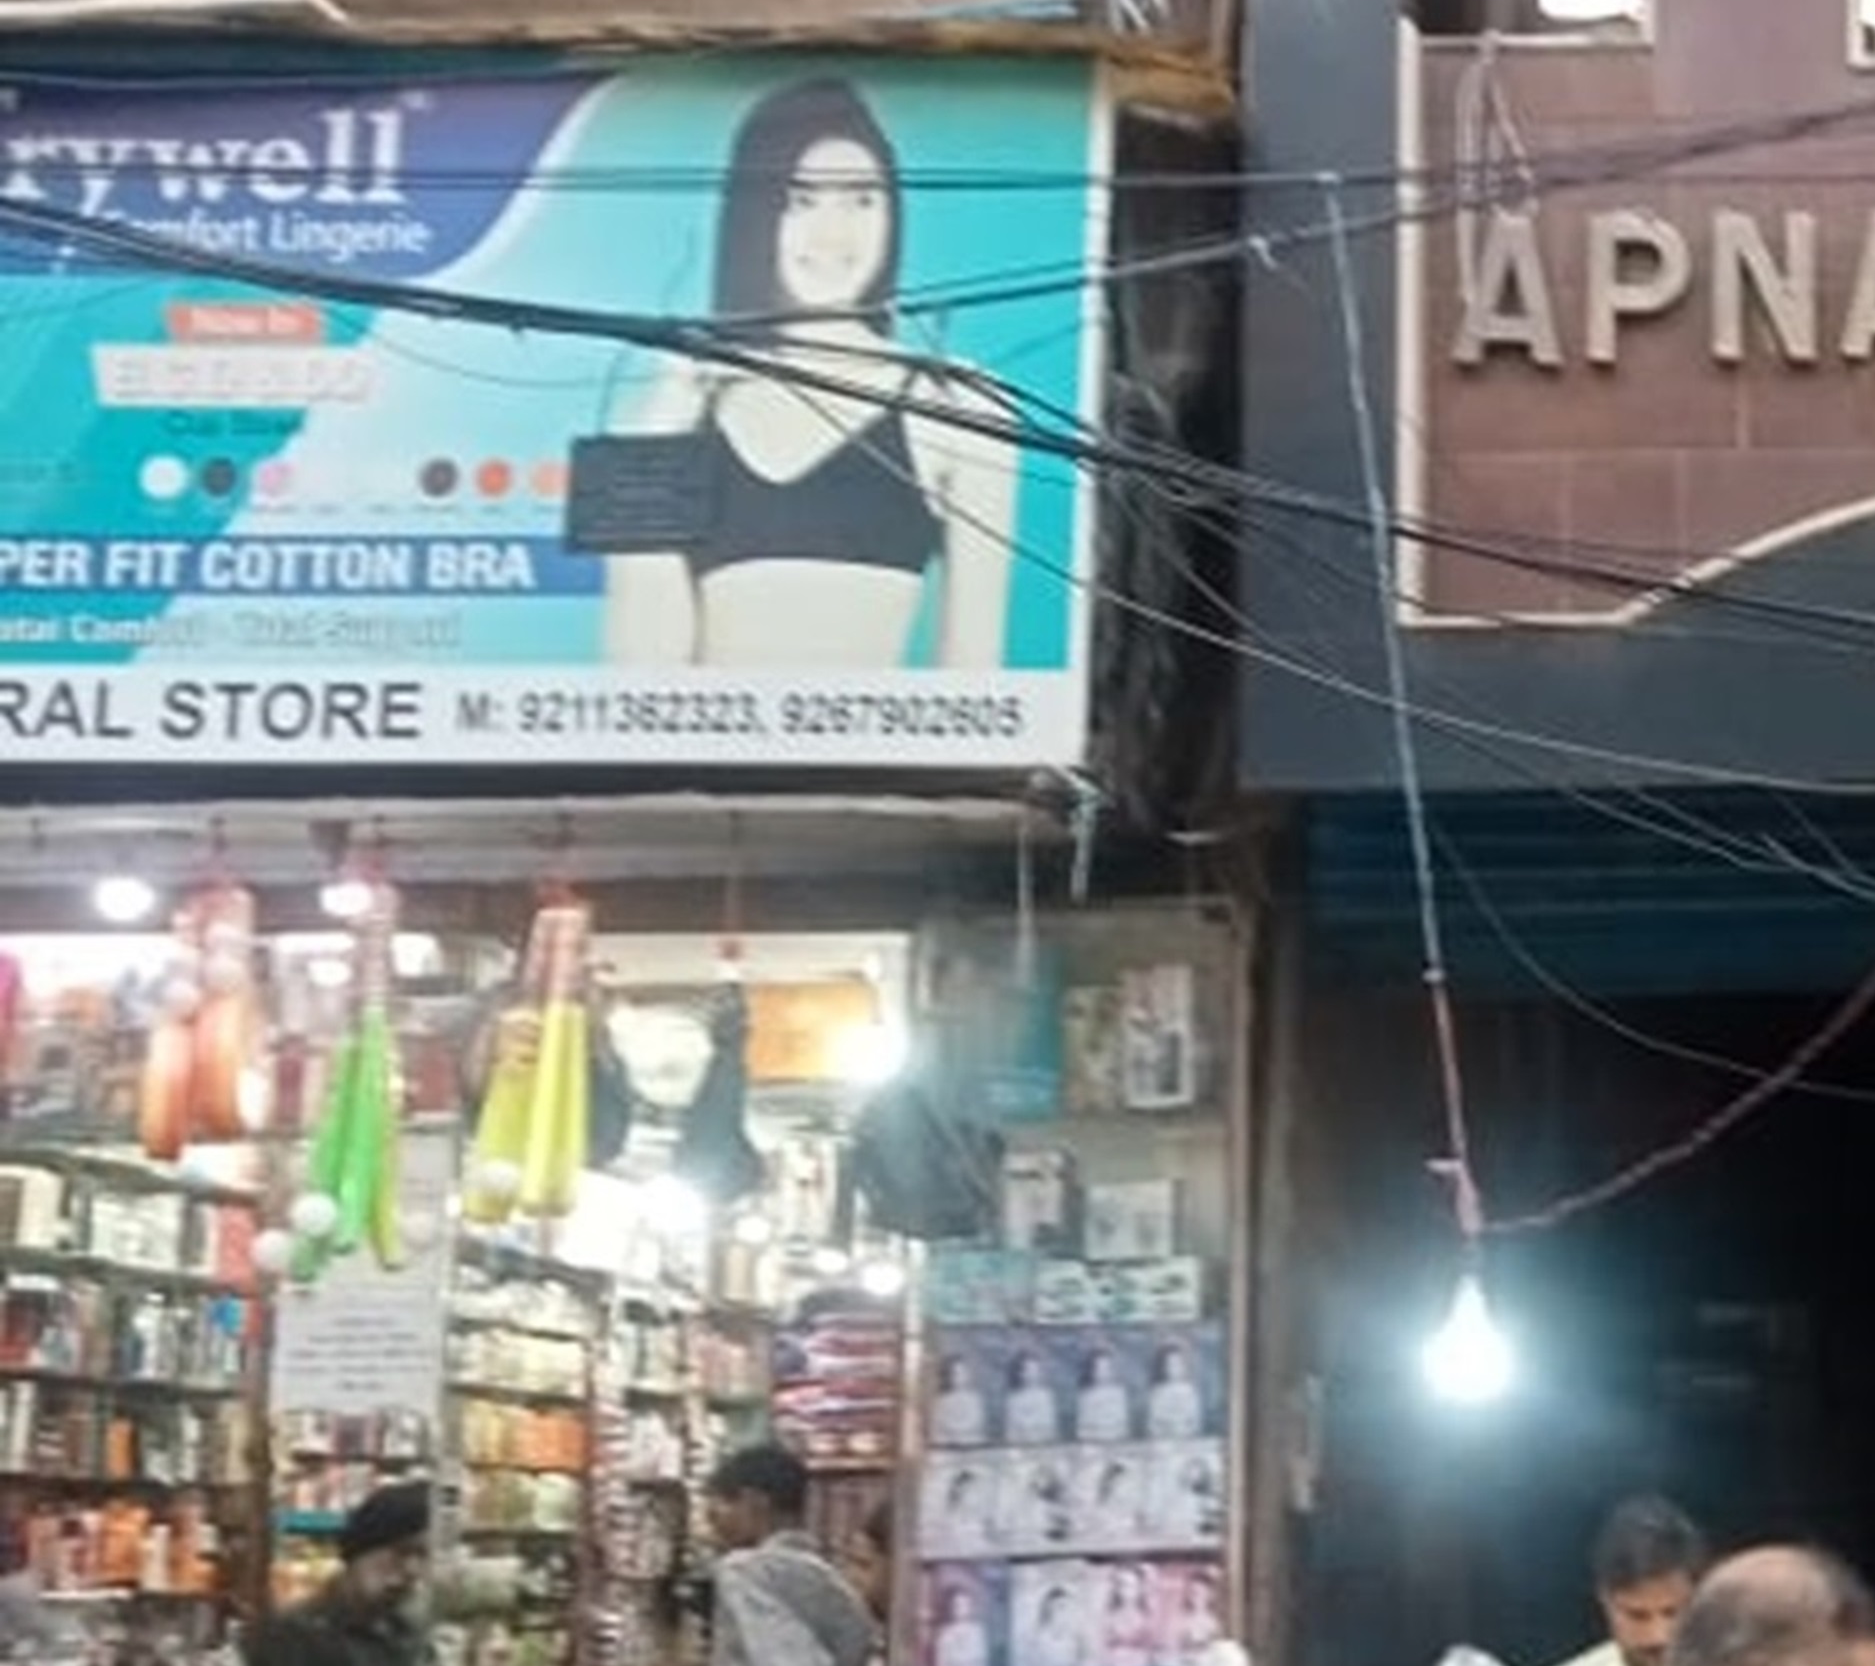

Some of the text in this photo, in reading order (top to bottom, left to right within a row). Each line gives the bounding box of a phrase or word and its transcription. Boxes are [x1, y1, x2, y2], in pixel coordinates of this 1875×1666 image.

[271, 207, 430, 263] Lingerie
[105, 542, 192, 588] FIT
[200, 542, 412, 590] COTTON
[427, 544, 537, 591] BRA
[160, 680, 424, 740] STORE
